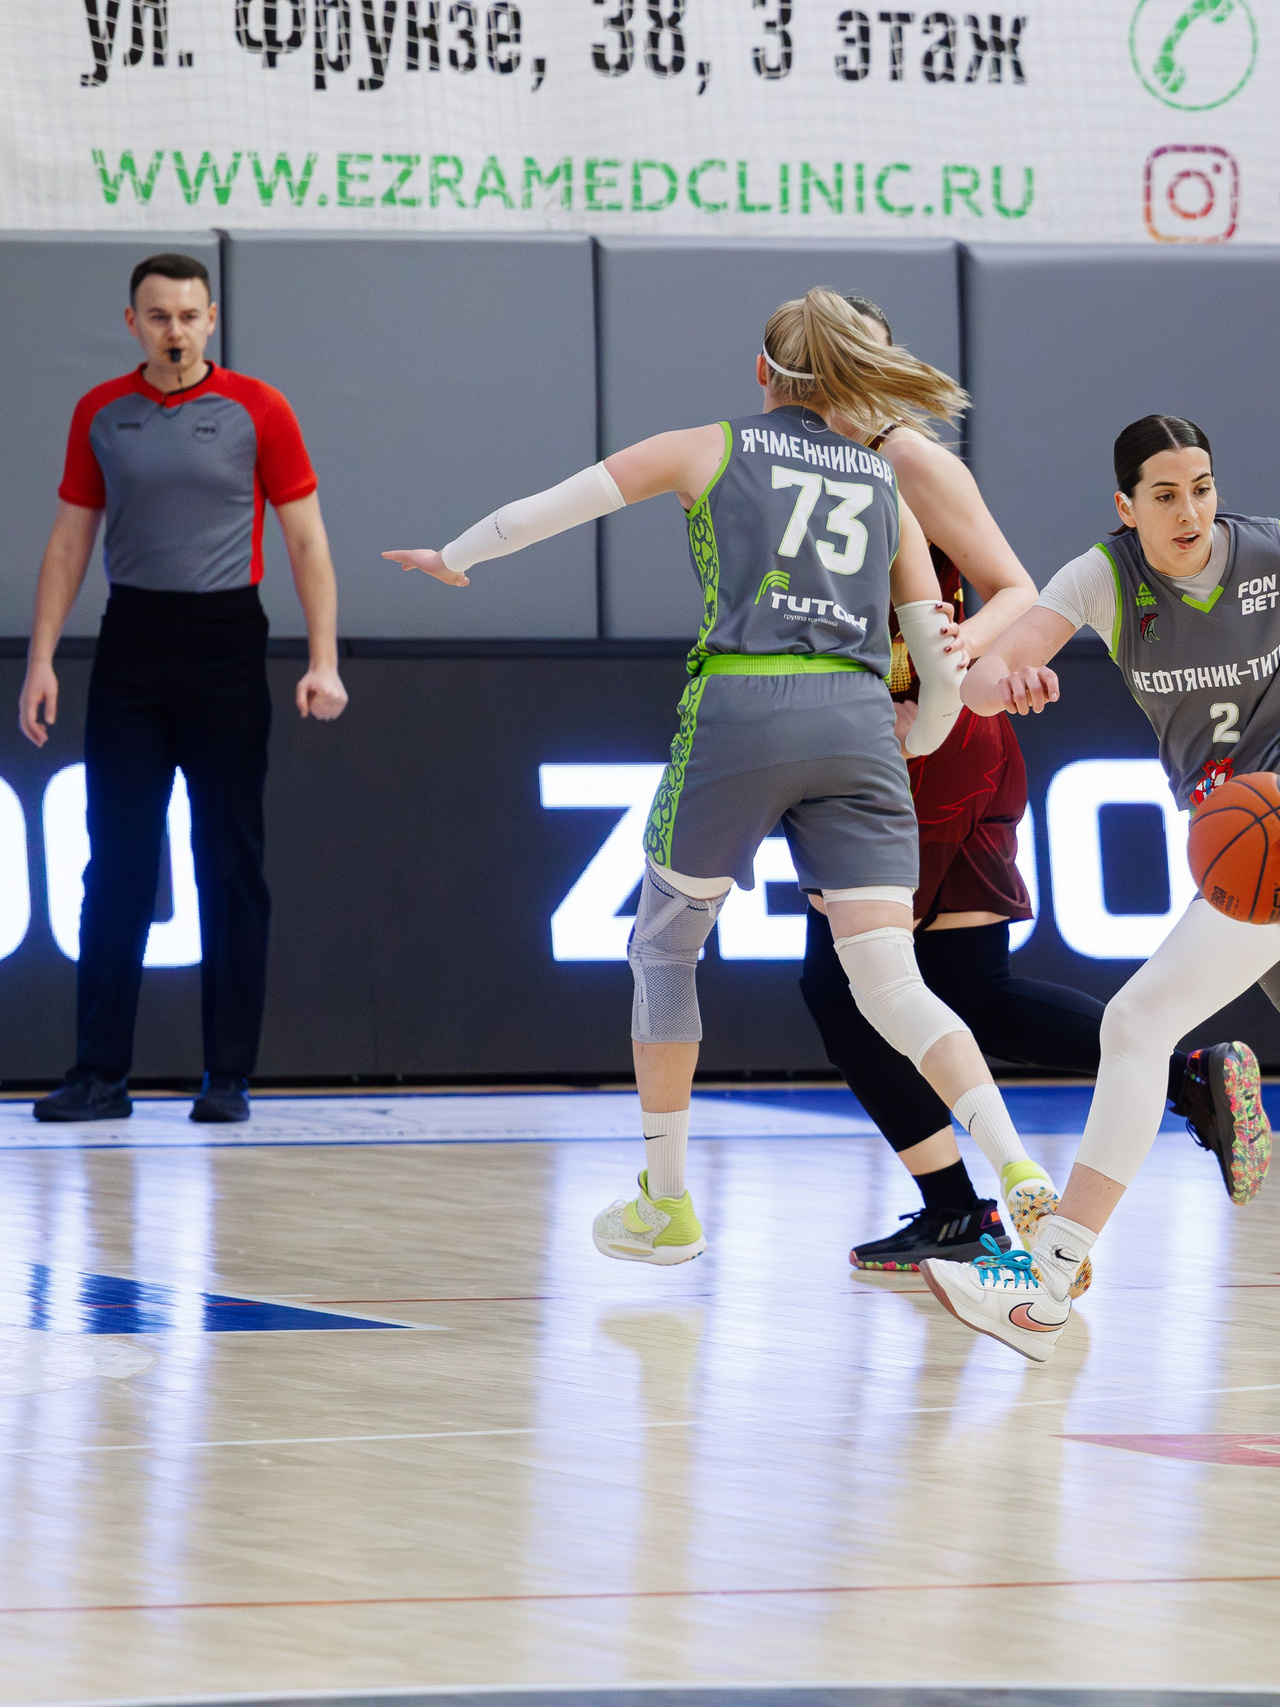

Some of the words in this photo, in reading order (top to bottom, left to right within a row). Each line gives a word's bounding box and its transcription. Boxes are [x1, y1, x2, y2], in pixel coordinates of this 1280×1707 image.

[81, 0, 193, 87] ул.
[234, 0, 547, 91] Фрунзе,
[591, 0, 711, 96] 38,
[752, 0, 793, 80] 3
[835, 10, 1028, 85] этаж
[92, 148, 1036, 219] WWW.EZRAMEDCLINIC.RU
[741, 428, 894, 487] ЯЧМЕННИКОВА
[771, 465, 874, 576] 73
[1238, 574, 1277, 598] FON
[1241, 591, 1279, 616] BET
[1210, 702, 1241, 744] 2
